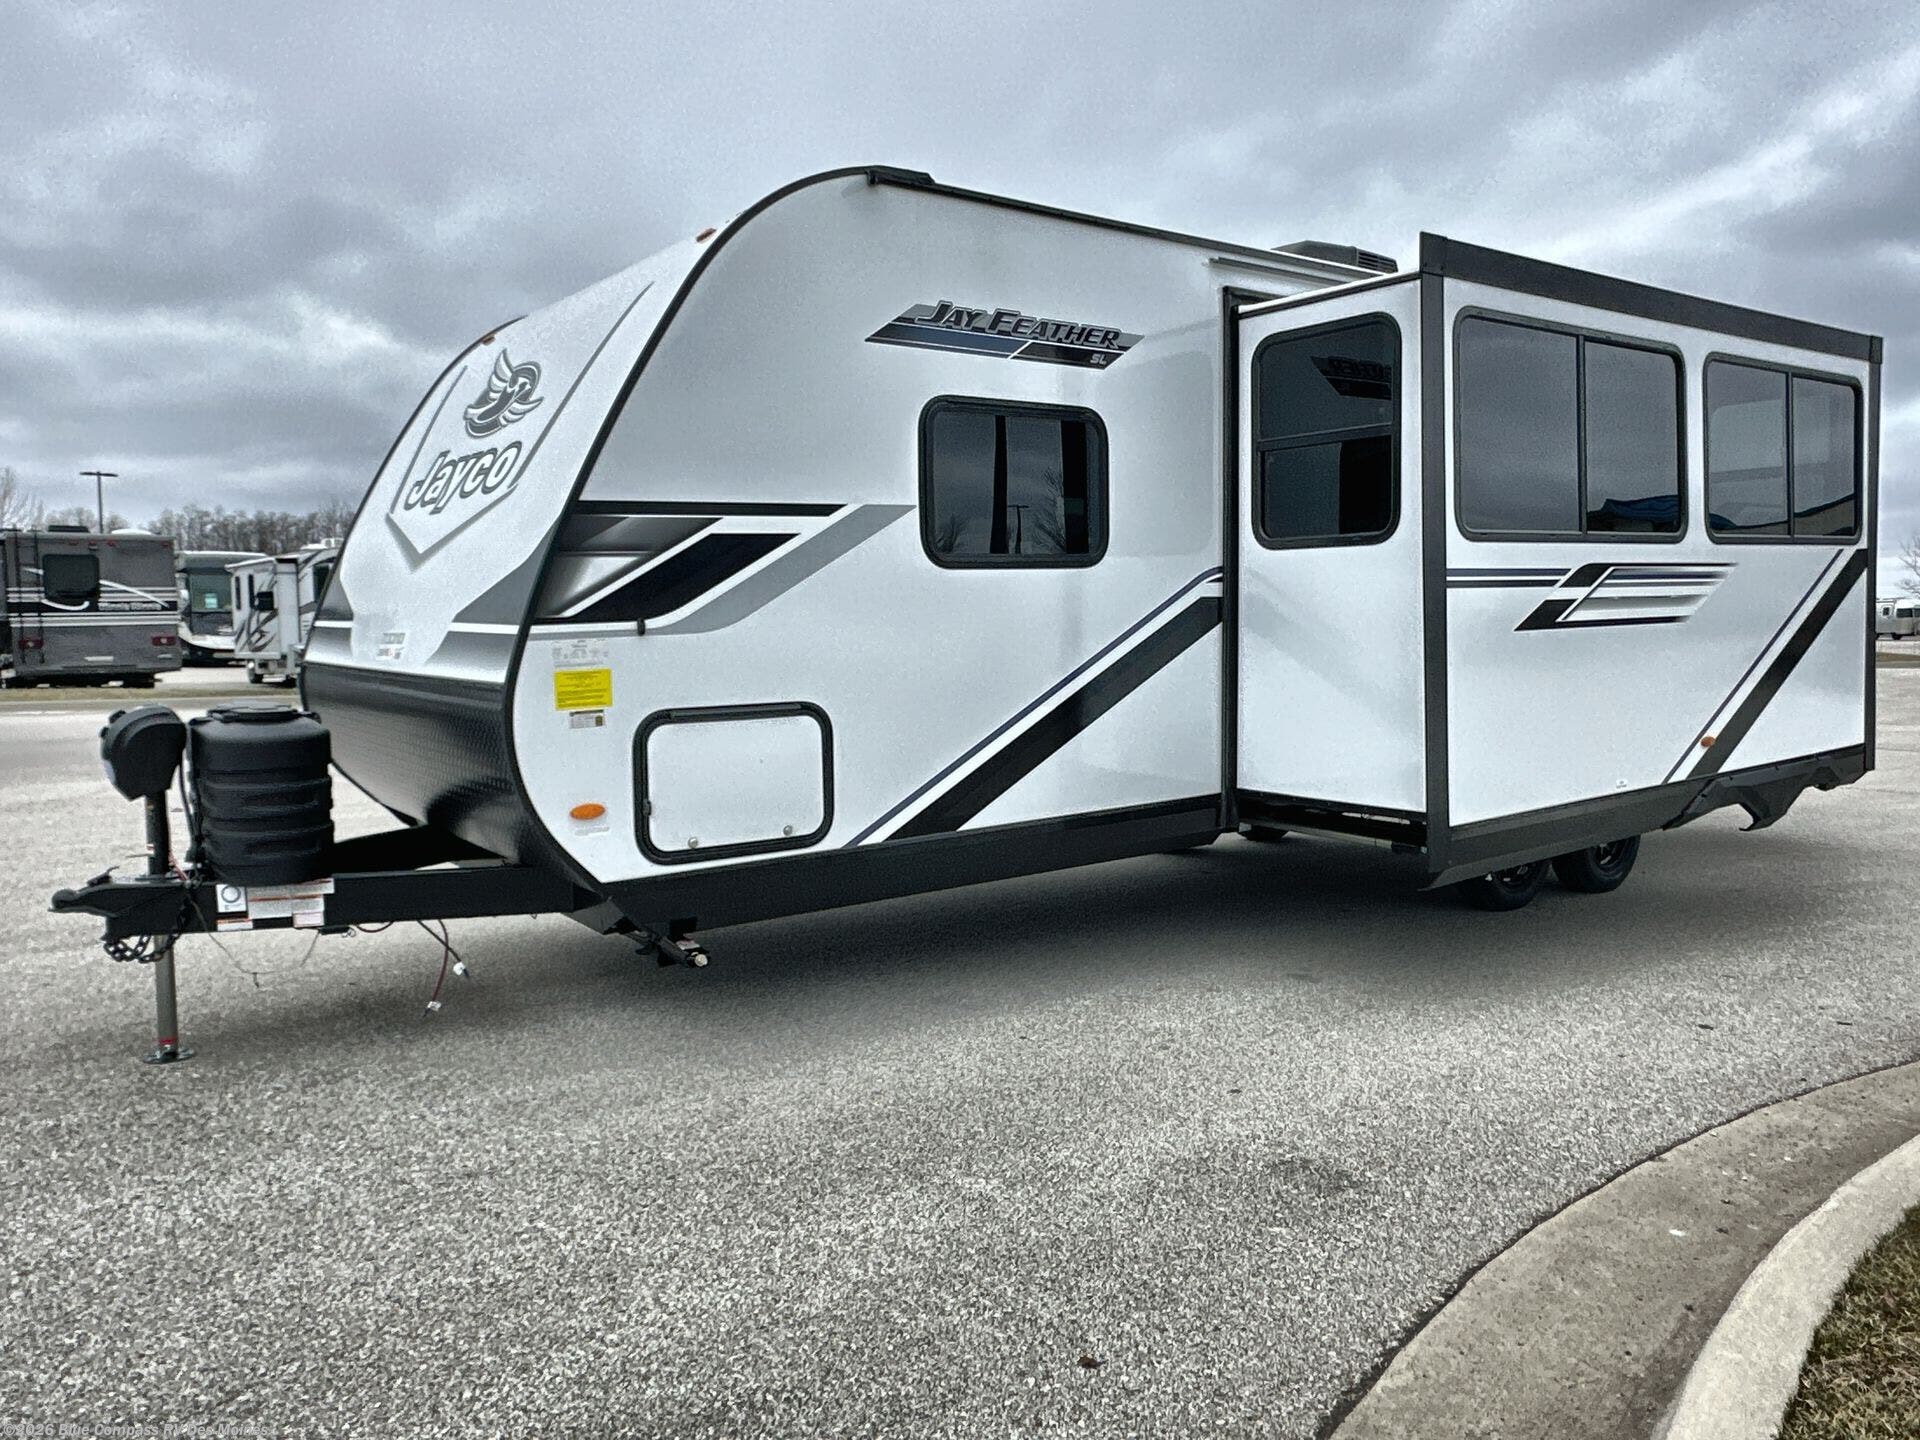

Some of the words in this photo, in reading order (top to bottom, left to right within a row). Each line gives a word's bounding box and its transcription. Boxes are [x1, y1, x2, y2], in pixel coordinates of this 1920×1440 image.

[914, 300, 987, 330] JAY
[985, 308, 1122, 350] FEATHER
[1090, 353, 1107, 365] SL
[403, 440, 523, 516] Jayco
